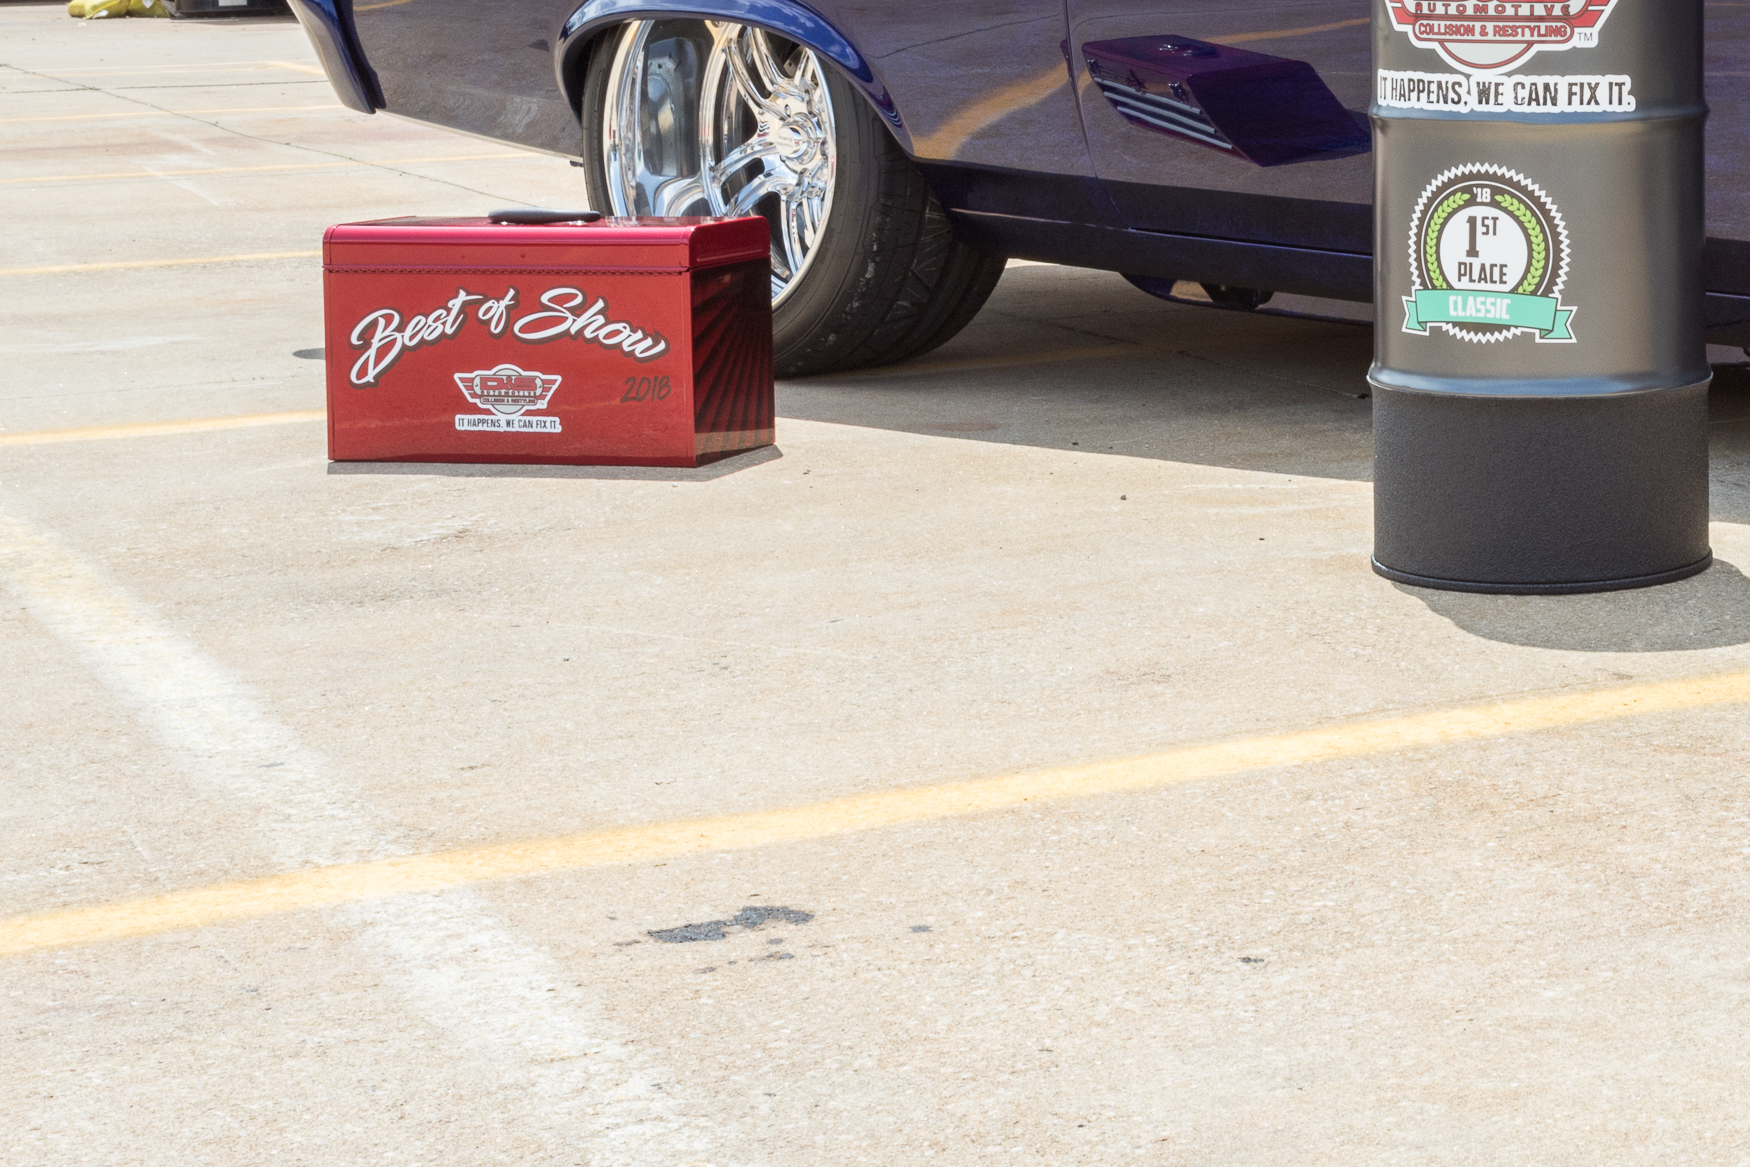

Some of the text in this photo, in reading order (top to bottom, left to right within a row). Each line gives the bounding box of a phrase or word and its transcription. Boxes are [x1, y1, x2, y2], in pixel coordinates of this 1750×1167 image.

[1415, 2, 1571, 16] AUTOMOTIVE
[1418, 22, 1568, 38] COLLISION & RESTYLING
[1379, 76, 1631, 107] IT HAPPENS, WE CAN FIX IT.
[1473, 187, 1491, 203] '18
[1457, 262, 1508, 285] PLACE
[1449, 295, 1511, 319] CLASSIC
[350, 287, 666, 385] Best of Show
[620, 375, 671, 403] 2018
[458, 418, 465, 427] IT
[506, 419, 516, 428] WE
[518, 419, 533, 429] CAN
[536, 420, 547, 429] FIX
[550, 420, 559, 430] IT.
